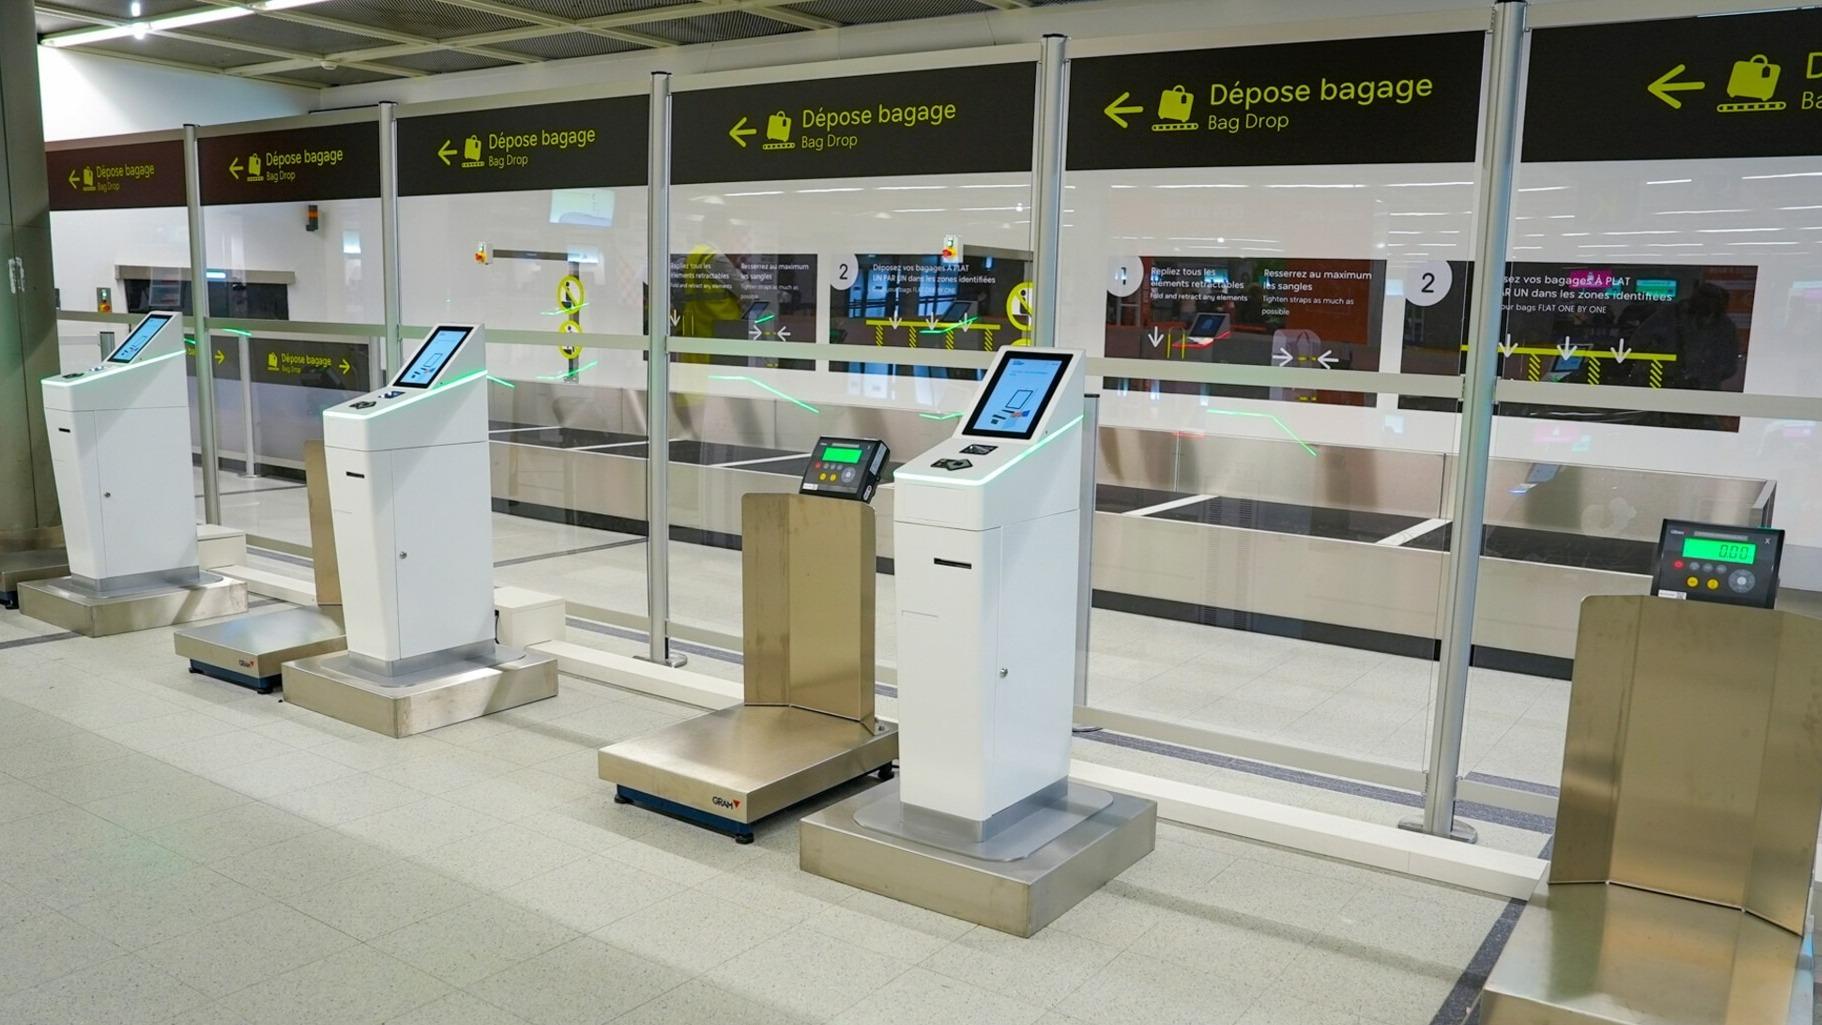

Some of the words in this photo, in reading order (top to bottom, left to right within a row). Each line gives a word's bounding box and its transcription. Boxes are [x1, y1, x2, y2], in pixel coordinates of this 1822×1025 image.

[1806, 52, 1822, 79] D
[1210, 80, 1310, 110] Dépose
[1320, 78, 1433, 105] bagage
[1801, 91, 1822, 110] Ba
[802, 107, 872, 131] Dépose
[878, 104, 956, 127] bagage
[1208, 114, 1240, 133] Bag
[1245, 113, 1289, 131] Drop
[488, 132, 538, 152] Dépose
[541, 129, 596, 148] bagage
[801, 135, 823, 151] Bag
[827, 134, 858, 149] Drop
[266, 151, 302, 168] Dépose
[304, 149, 343, 166] bagage
[488, 155, 504, 168] Bag
[506, 154, 528, 167] Drop
[96, 164, 124, 179] Dépose
[125, 163, 155, 179] bagage
[266, 171, 278, 182] Bag
[280, 170, 295, 181] Drop
[97, 182, 107, 192] Bag
[107, 181, 120, 191] Drop
[839, 264, 848, 280] 2
[915, 264, 945, 273] bagages
[1151, 266, 1180, 281] Repliez
[1182, 267, 1201, 276] tous
[1203, 267, 1216, 276] les
[1263, 268, 1307, 278] Resserrez
[1309, 270, 1321, 279] au
[1323, 270, 1372, 280] maximum
[750, 272, 772, 281] sangles
[1421, 272, 1435, 293] 2
[1504, 276, 1521, 284] sez
[1523, 276, 1542, 284] vos
[1544, 274, 1592, 287] bagages
[1605, 277, 1631, 286] PLAT
[1263, 281, 1276, 290] les
[1277, 282, 1312, 293] sangles
[1513, 288, 1529, 297] UN
[1531, 288, 1557, 298] dans
[1560, 289, 1575, 299] les
[1578, 291, 1610, 300] zones
[1165, 292, 1178, 300] and
[1179, 293, 1201, 301] retract
[1203, 294, 1215, 302] any
[1216, 293, 1248, 302] elements
[1263, 295, 1289, 304] Tighten
[1290, 296, 1312, 305] straps
[1323, 296, 1344, 305] much
[1345, 298, 1354, 306] as
[1262, 308, 1290, 317] possible
[1515, 303, 1537, 313] bags
[1538, 304, 1556, 312] FLAT
[1558, 304, 1575, 313] ONE
[1577, 304, 1588, 313] BY
[1589, 305, 1607, 314] ONE
[306, 354, 332, 368] bagage
[1718, 543, 1749, 560] 0.00
[712, 796, 734, 810] GRAM
